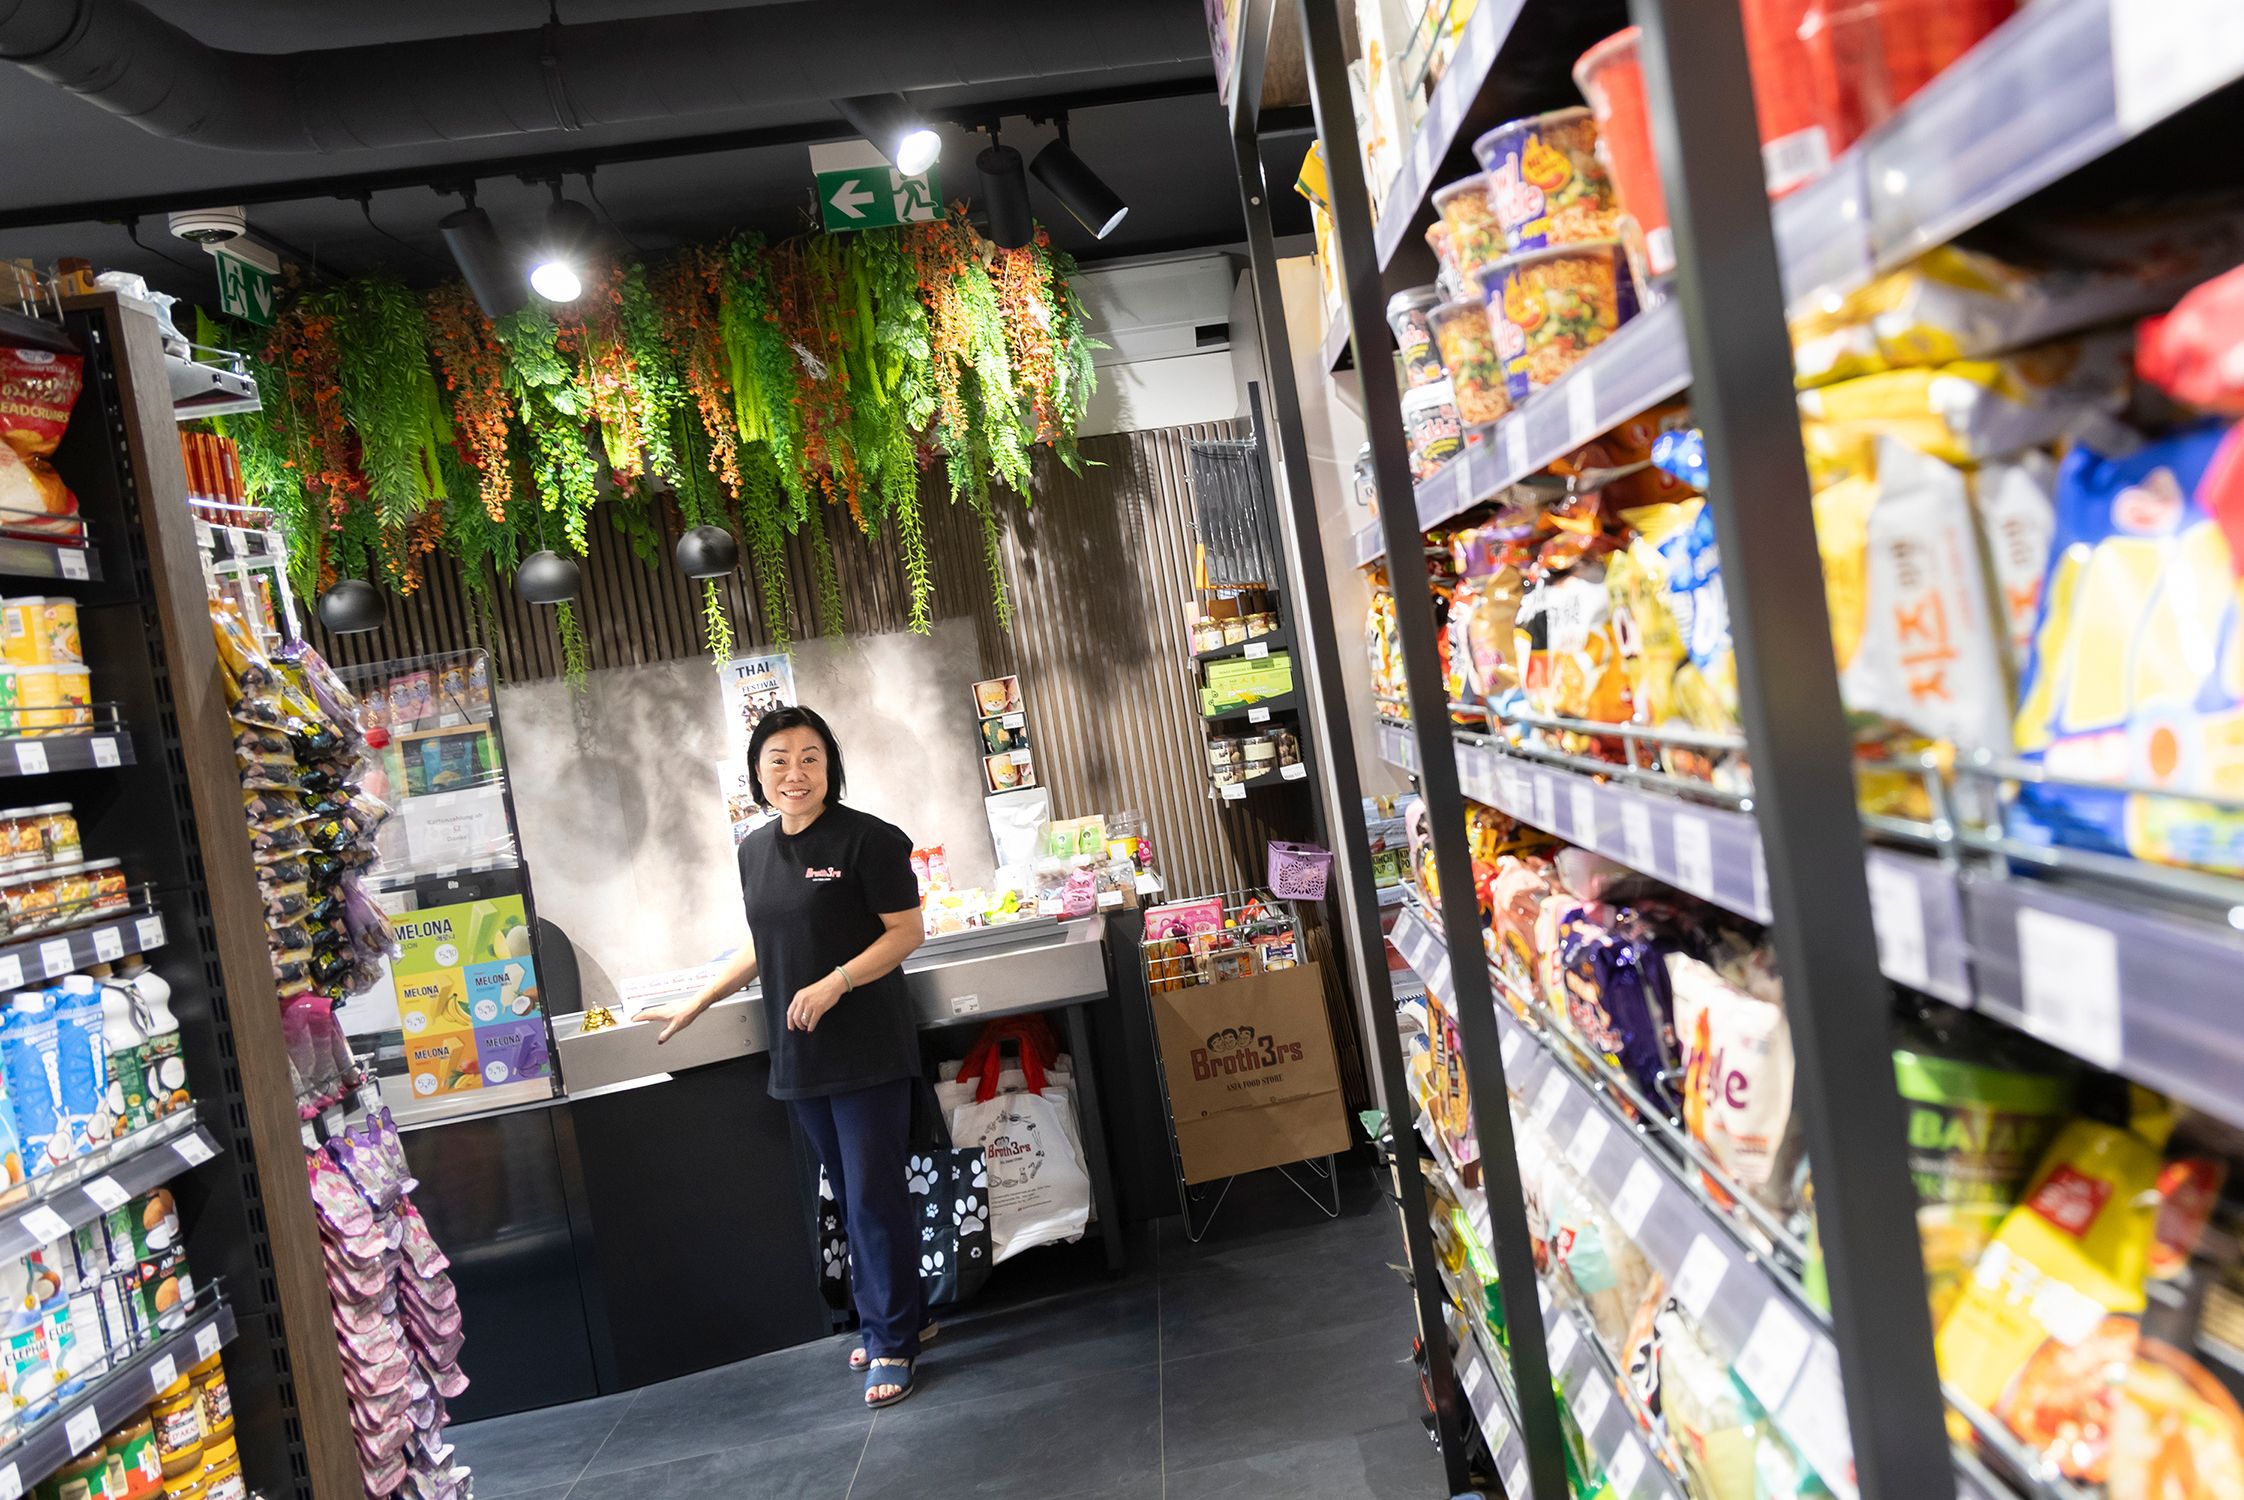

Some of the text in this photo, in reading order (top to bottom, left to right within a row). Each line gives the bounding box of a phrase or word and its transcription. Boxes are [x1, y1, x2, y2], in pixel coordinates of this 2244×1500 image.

[735, 661, 771, 679] THAI
[742, 679, 778, 694] FESTIVAL
[1373, 853, 1393, 864] KIMCHI
[1373, 865, 1386, 875] POP
[394, 918, 453, 941] MELONA
[475, 972, 511, 987] MELONA
[404, 985, 440, 999] MELONA
[485, 1034, 521, 1048] MELONA
[414, 1046, 450, 1060] MELONA
[1190, 1034, 1304, 1082] Broth3rs
[1226, 1074, 1284, 1092] ASIA FOOD STORE
[988, 1141, 1032, 1159] Broth3rs
